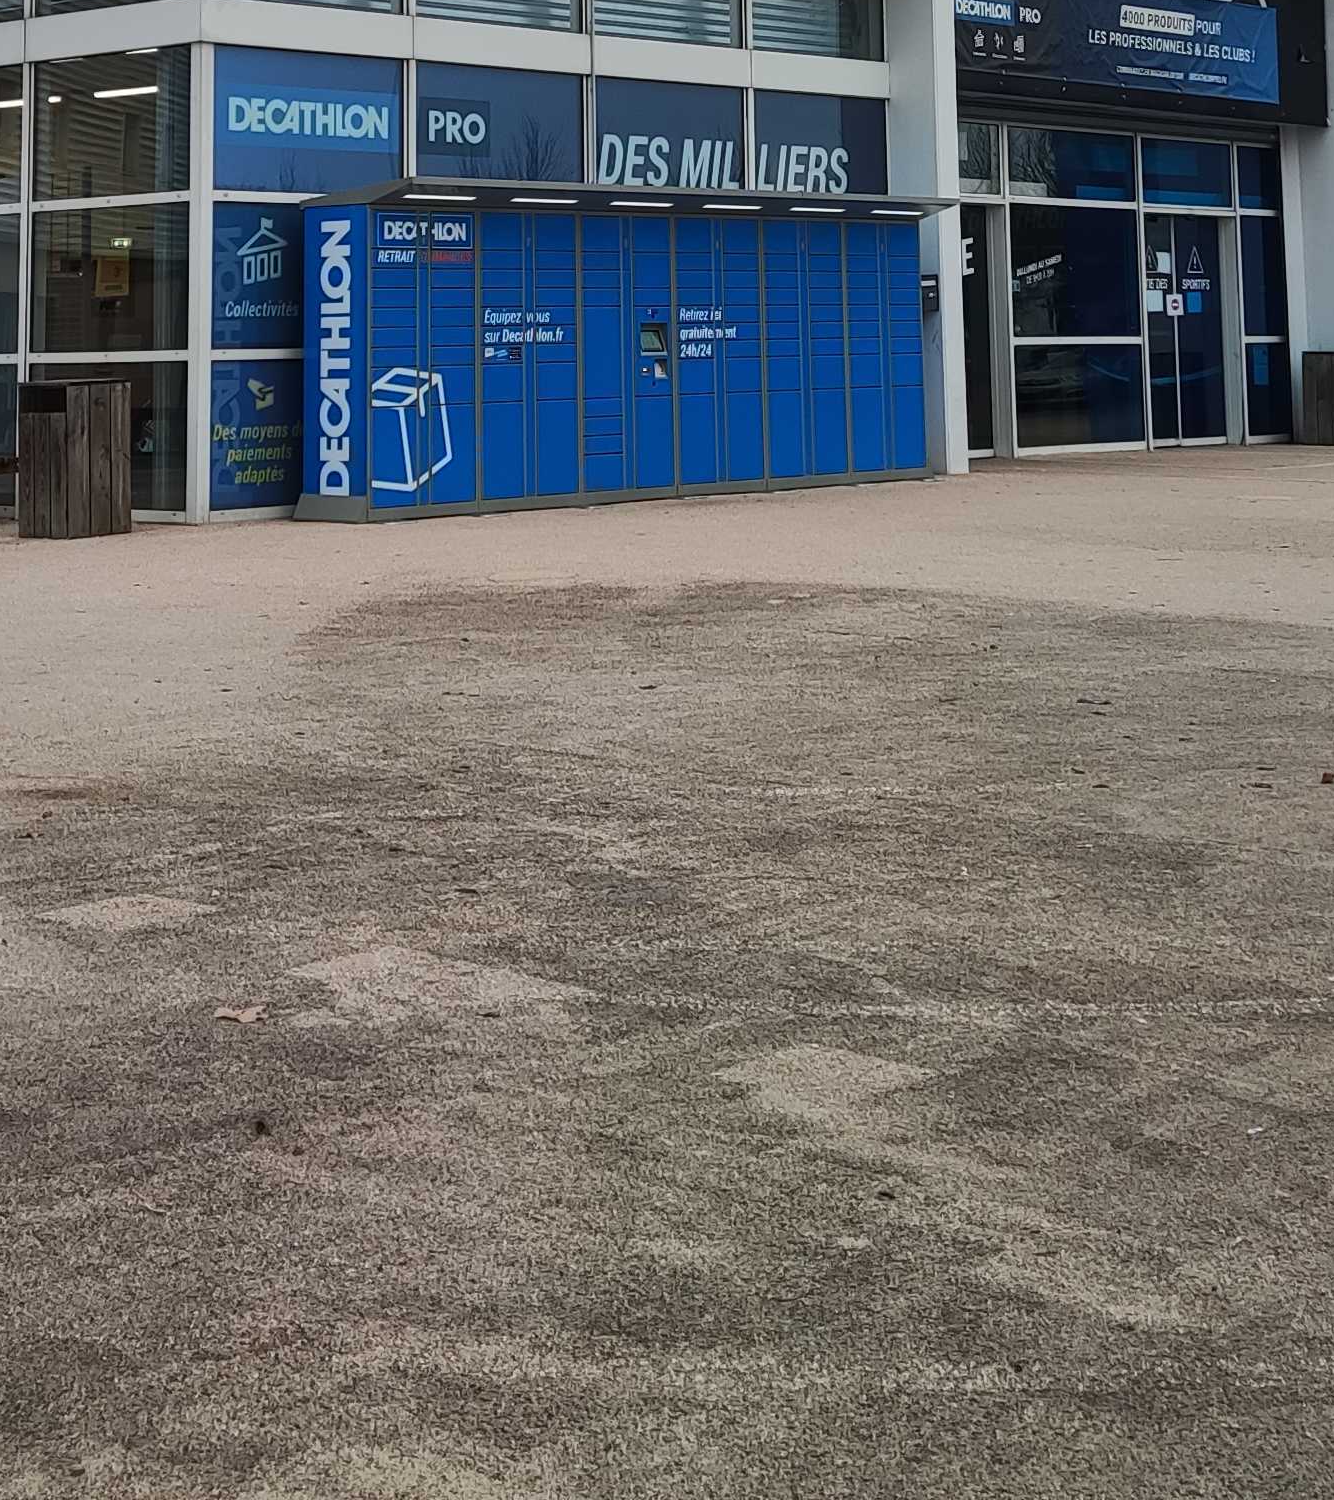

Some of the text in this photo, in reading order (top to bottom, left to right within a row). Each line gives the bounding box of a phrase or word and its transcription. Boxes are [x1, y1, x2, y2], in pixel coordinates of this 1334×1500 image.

[1019, 6, 1042, 24] PRO
[1121, 9, 1222, 36] 4000 PRODUITS POUR
[1088, 29, 1107, 45] LES
[1109, 32, 1193, 56] PROFESSIONNELS
[1203, 45, 1220, 59] LES
[227, 96, 486, 145] DECATHLON PRO
[598, 133, 670, 187] DES
[378, 249, 416, 263] RETRAIT
[1181, 278, 1211, 291] SPORTIFS
[225, 300, 300, 318] Collectivités
[679, 308, 708, 321] Retirez
[484, 329, 501, 343] sur
[319, 219, 351, 496] DECATHLON
[680, 344, 712, 358] 24h/24
[213, 424, 237, 441] Des
[240, 424, 288, 444] moyens
[226, 444, 292, 466] paiements
[234, 465, 285, 486] adaptés
